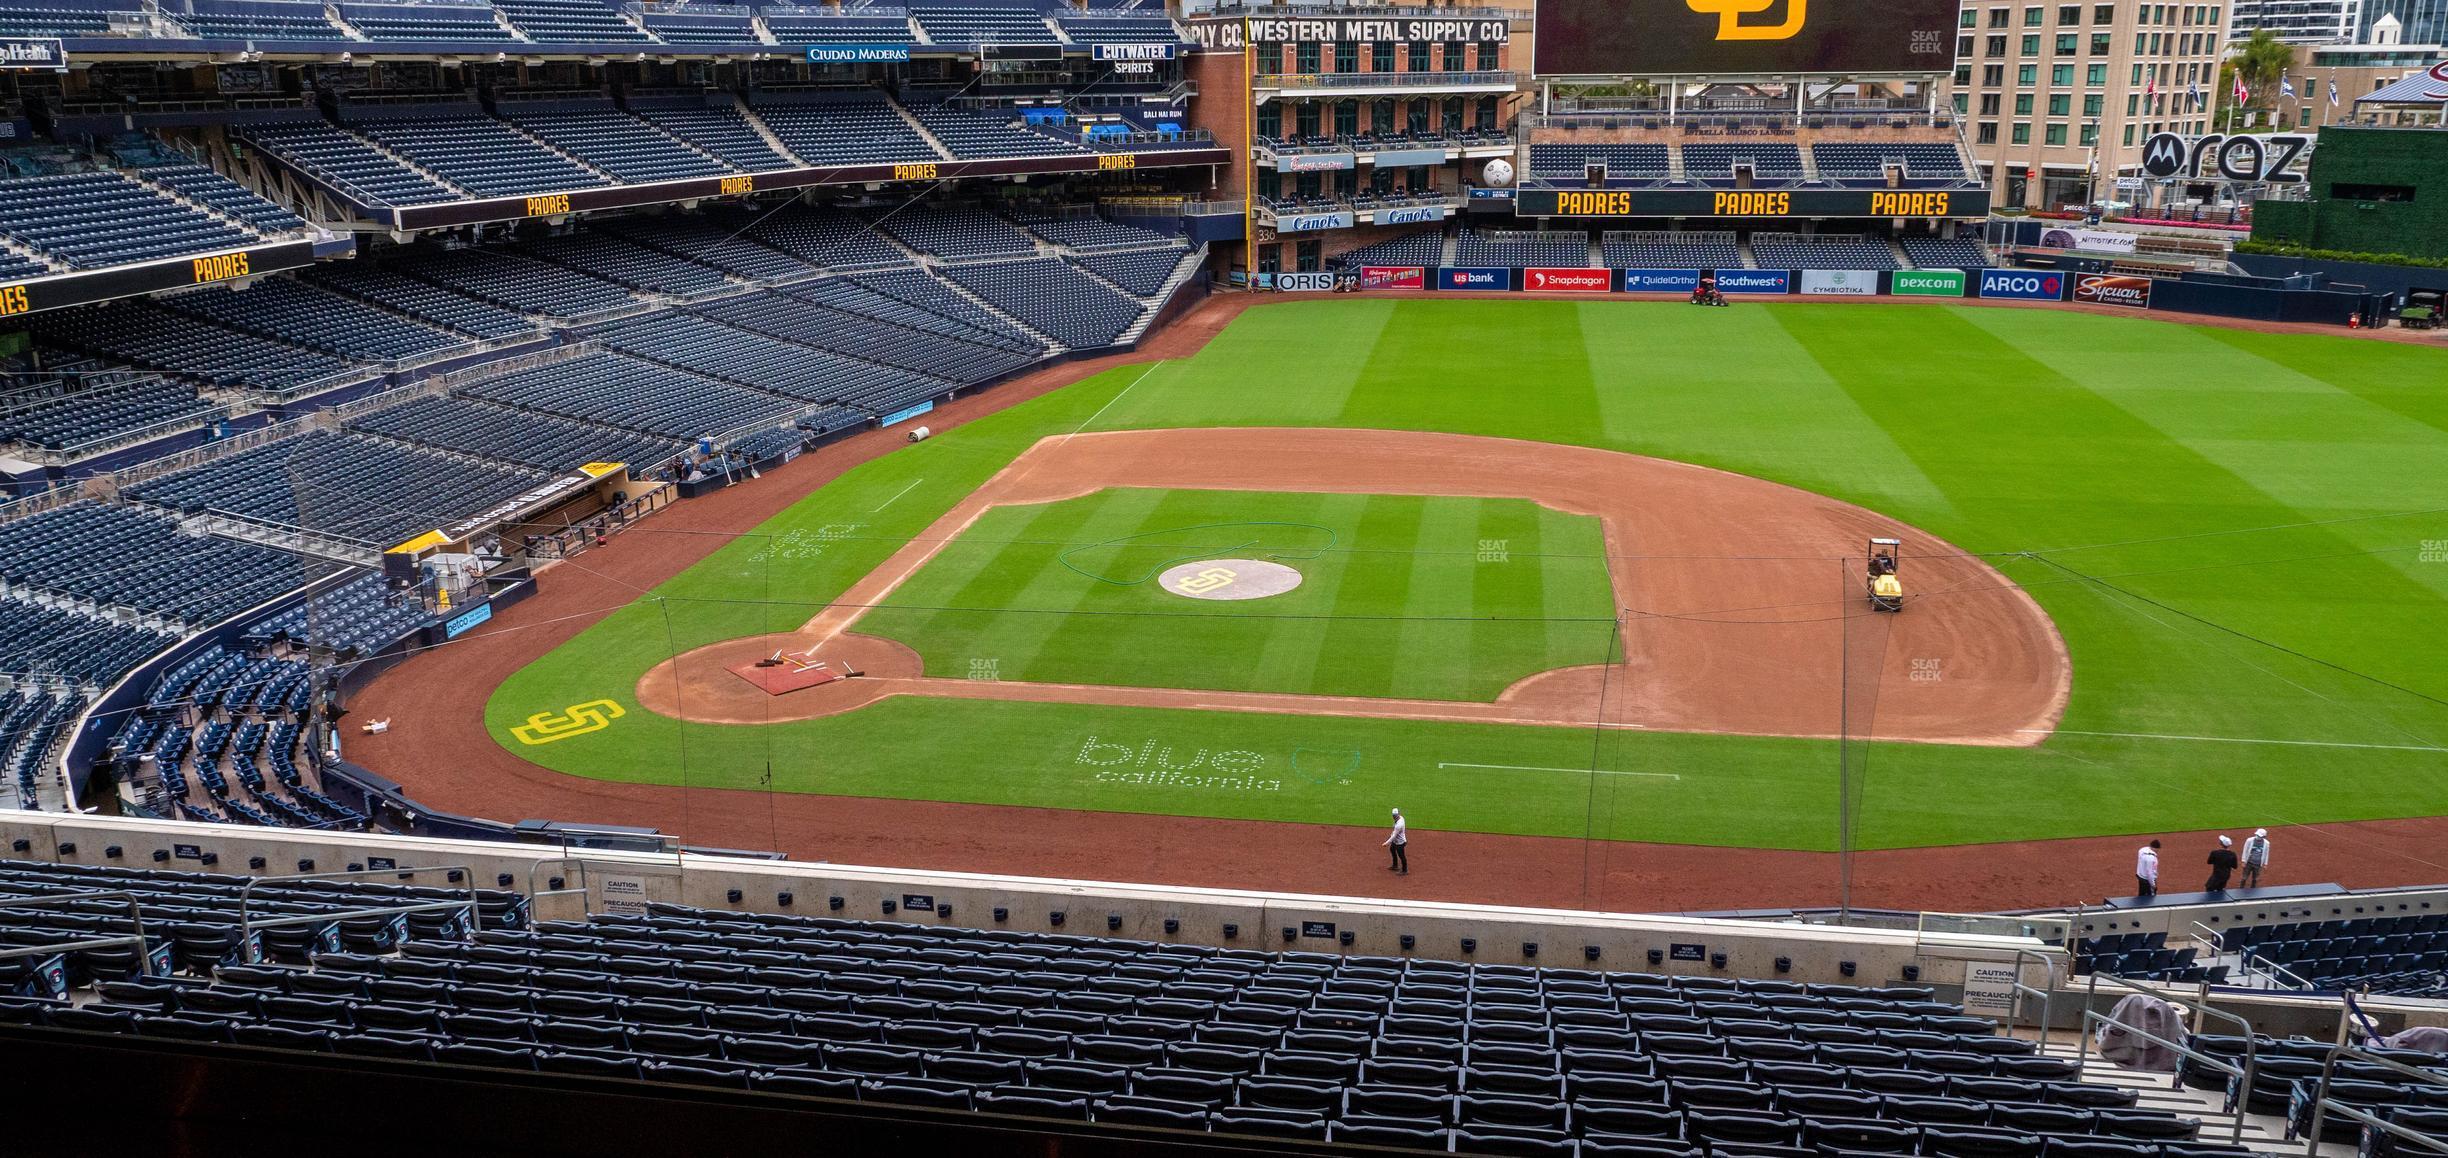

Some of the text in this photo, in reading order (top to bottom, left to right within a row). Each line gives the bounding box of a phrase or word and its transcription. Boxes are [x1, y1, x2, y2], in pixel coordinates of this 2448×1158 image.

[1221, 23, 1246, 47] CO.
[1248, 20, 1508, 41] WESTERN METAL SUPPLY CO.
[810, 48, 908, 60] CIUDAD MADERAS
[1102, 45, 1166, 59] CUTWATER
[1115, 63, 1154, 73] SPIRITS
[1098, 155, 1135, 169] PADRES
[2190, 133, 2316, 182] raz
[894, 164, 937, 179] PADRES
[720, 176, 753, 194] PADRES
[527, 194, 569, 216] PADRES
[1557, 192, 1631, 215] PADRES
[1714, 192, 1789, 215] PADRES
[1871, 192, 1948, 215] PADRES
[1292, 215, 1342, 231] Canel's
[1387, 207, 1433, 224] Canel's
[1258, 229, 1276, 241] 336
[193, 252, 250, 283] PADRES
[1280, 275, 1331, 290] ORIS
[1454, 272, 1494, 284] us bank
[1548, 274, 1605, 287] Snapdragon
[1642, 274, 1696, 286] QuidelOrtho
[1718, 275, 1776, 287] Southwest
[1983, 276, 2039, 293] ARCO
[1813, 286, 1864, 294] CYMBIOTIKA
[2078, 276, 2141, 302] Sycuan
[447, 617, 469, 637] petco
[1075, 736, 1265, 773] blue
[1095, 771, 1281, 791] california
[608, 880, 639, 888] CAUTION
[1976, 969, 2015, 977] CAUTION
